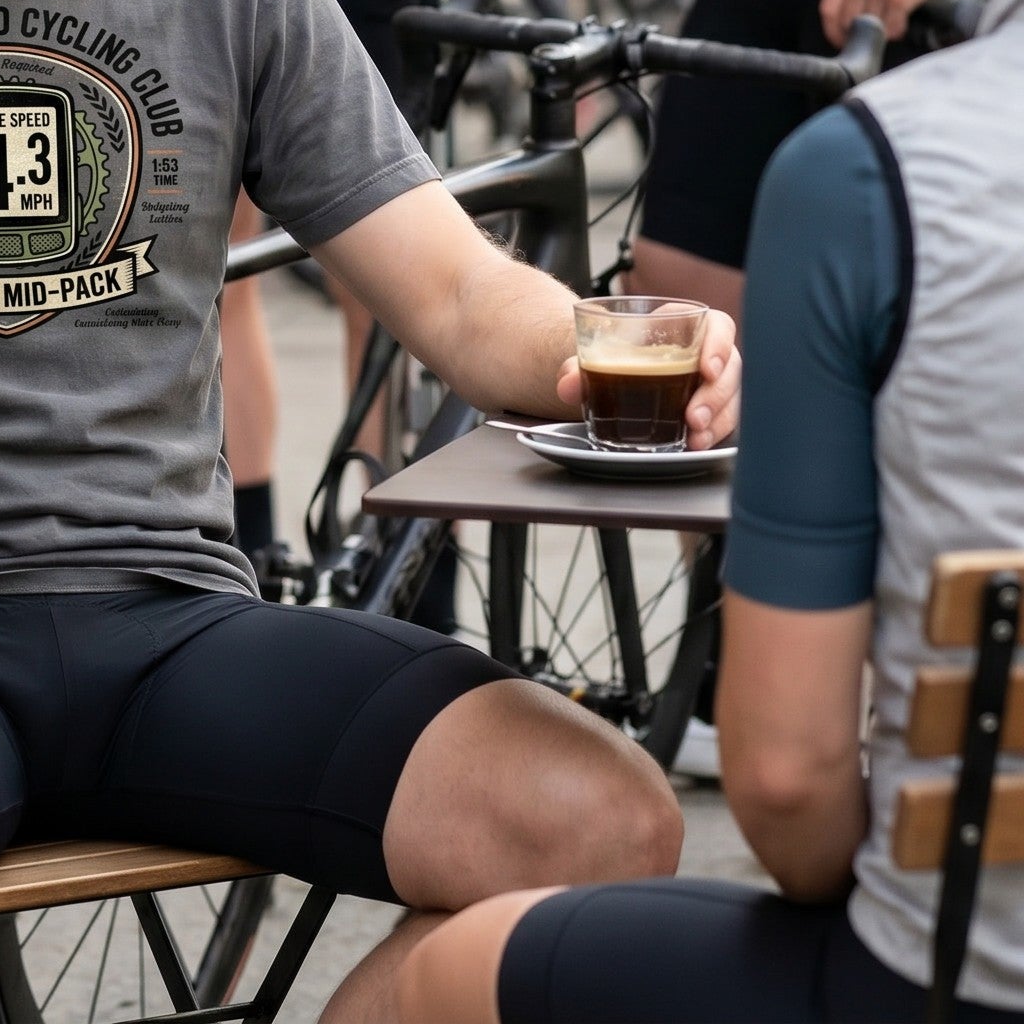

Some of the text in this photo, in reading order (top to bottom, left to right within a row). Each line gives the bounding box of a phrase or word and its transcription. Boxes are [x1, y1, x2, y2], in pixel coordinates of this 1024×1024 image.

[20, 7, 142, 75] CYCLING
[130, 68, 184, 137] CLUB
[10, 112, 50, 127] SPEED
[151, 158, 179, 172] 1:53
[153, 174, 178, 186] TIME
[20, 193, 53, 210] MPH
[3, 267, 122, 308] MID-PACK
